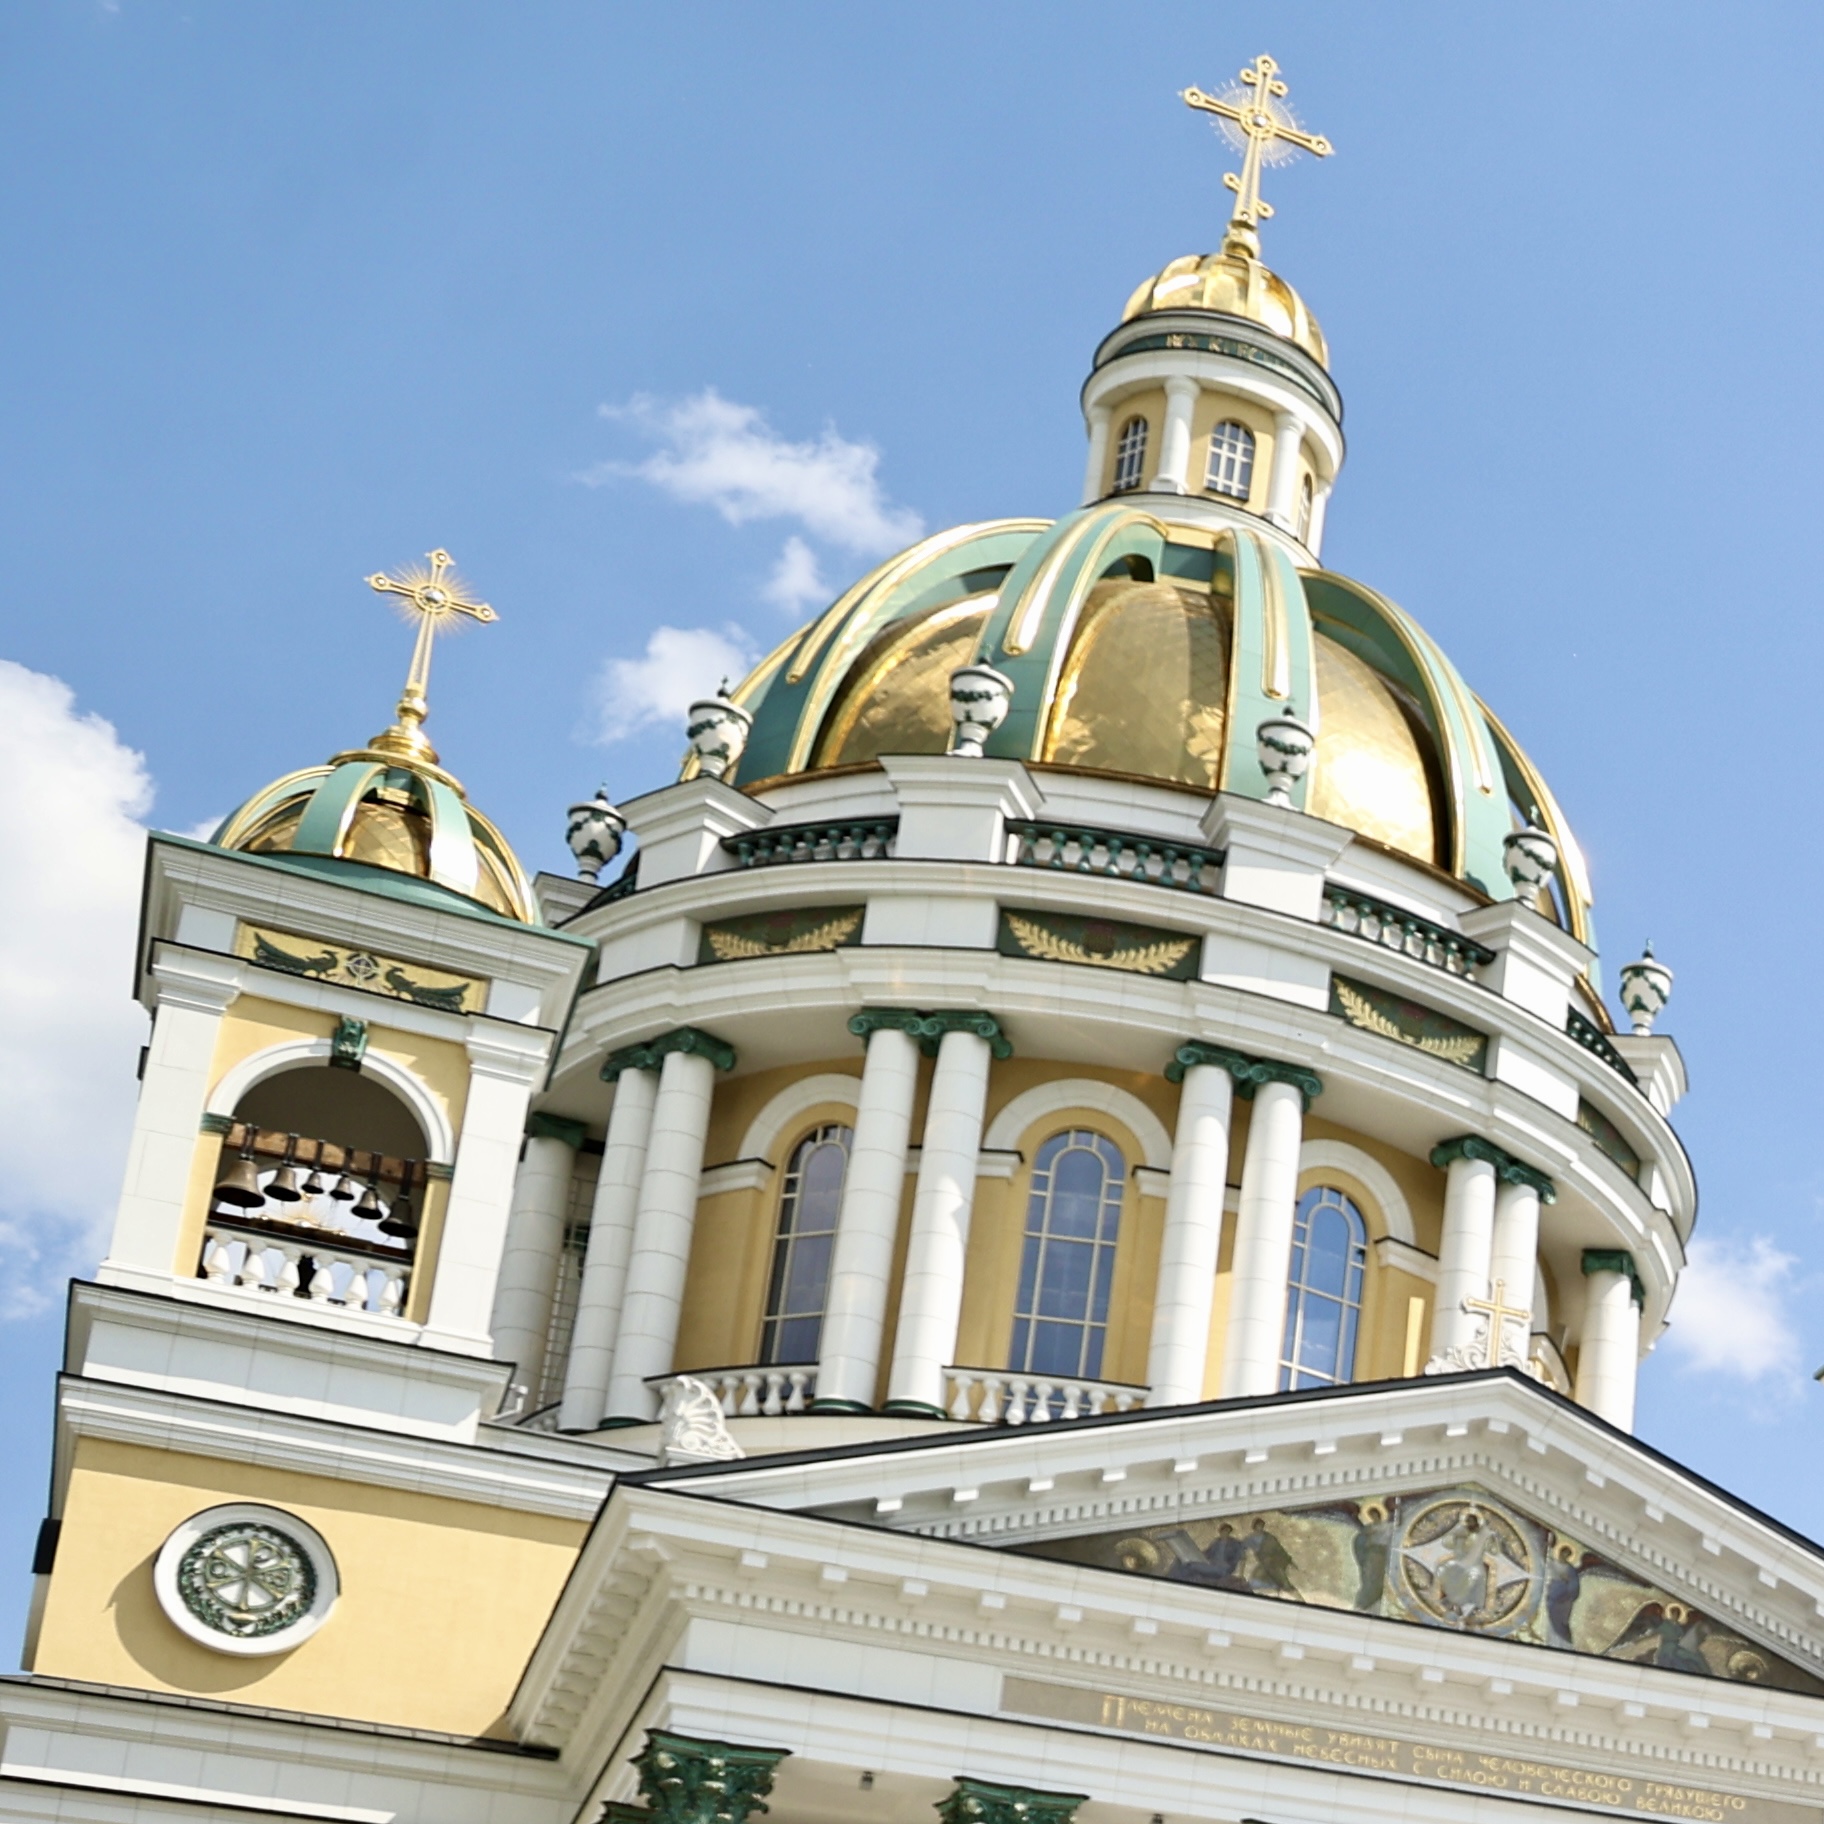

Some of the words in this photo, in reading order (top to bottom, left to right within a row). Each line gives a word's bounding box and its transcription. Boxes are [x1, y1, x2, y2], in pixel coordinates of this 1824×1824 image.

[1103, 1695, 1213, 1726] ПЛЕМЕНА
[1231, 1717, 1314, 1742] ЗЕМНЫЕ
[1325, 1730, 1399, 1754] УВИДЯТ
[1413, 1745, 1465, 1764] СЫНА
[1145, 1719, 1171, 1735] НА
[1184, 1725, 1278, 1752] ОБЛАКАХ
[1293, 1743, 1398, 1770] НЕБЕСНЫХ
[1437, 1765, 1507, 1788] СИЛОЮ
[1540, 1782, 1621, 1805] СЛАВОЮ
[1636, 1797, 1725, 1821] ВЕЛИКОЮ
